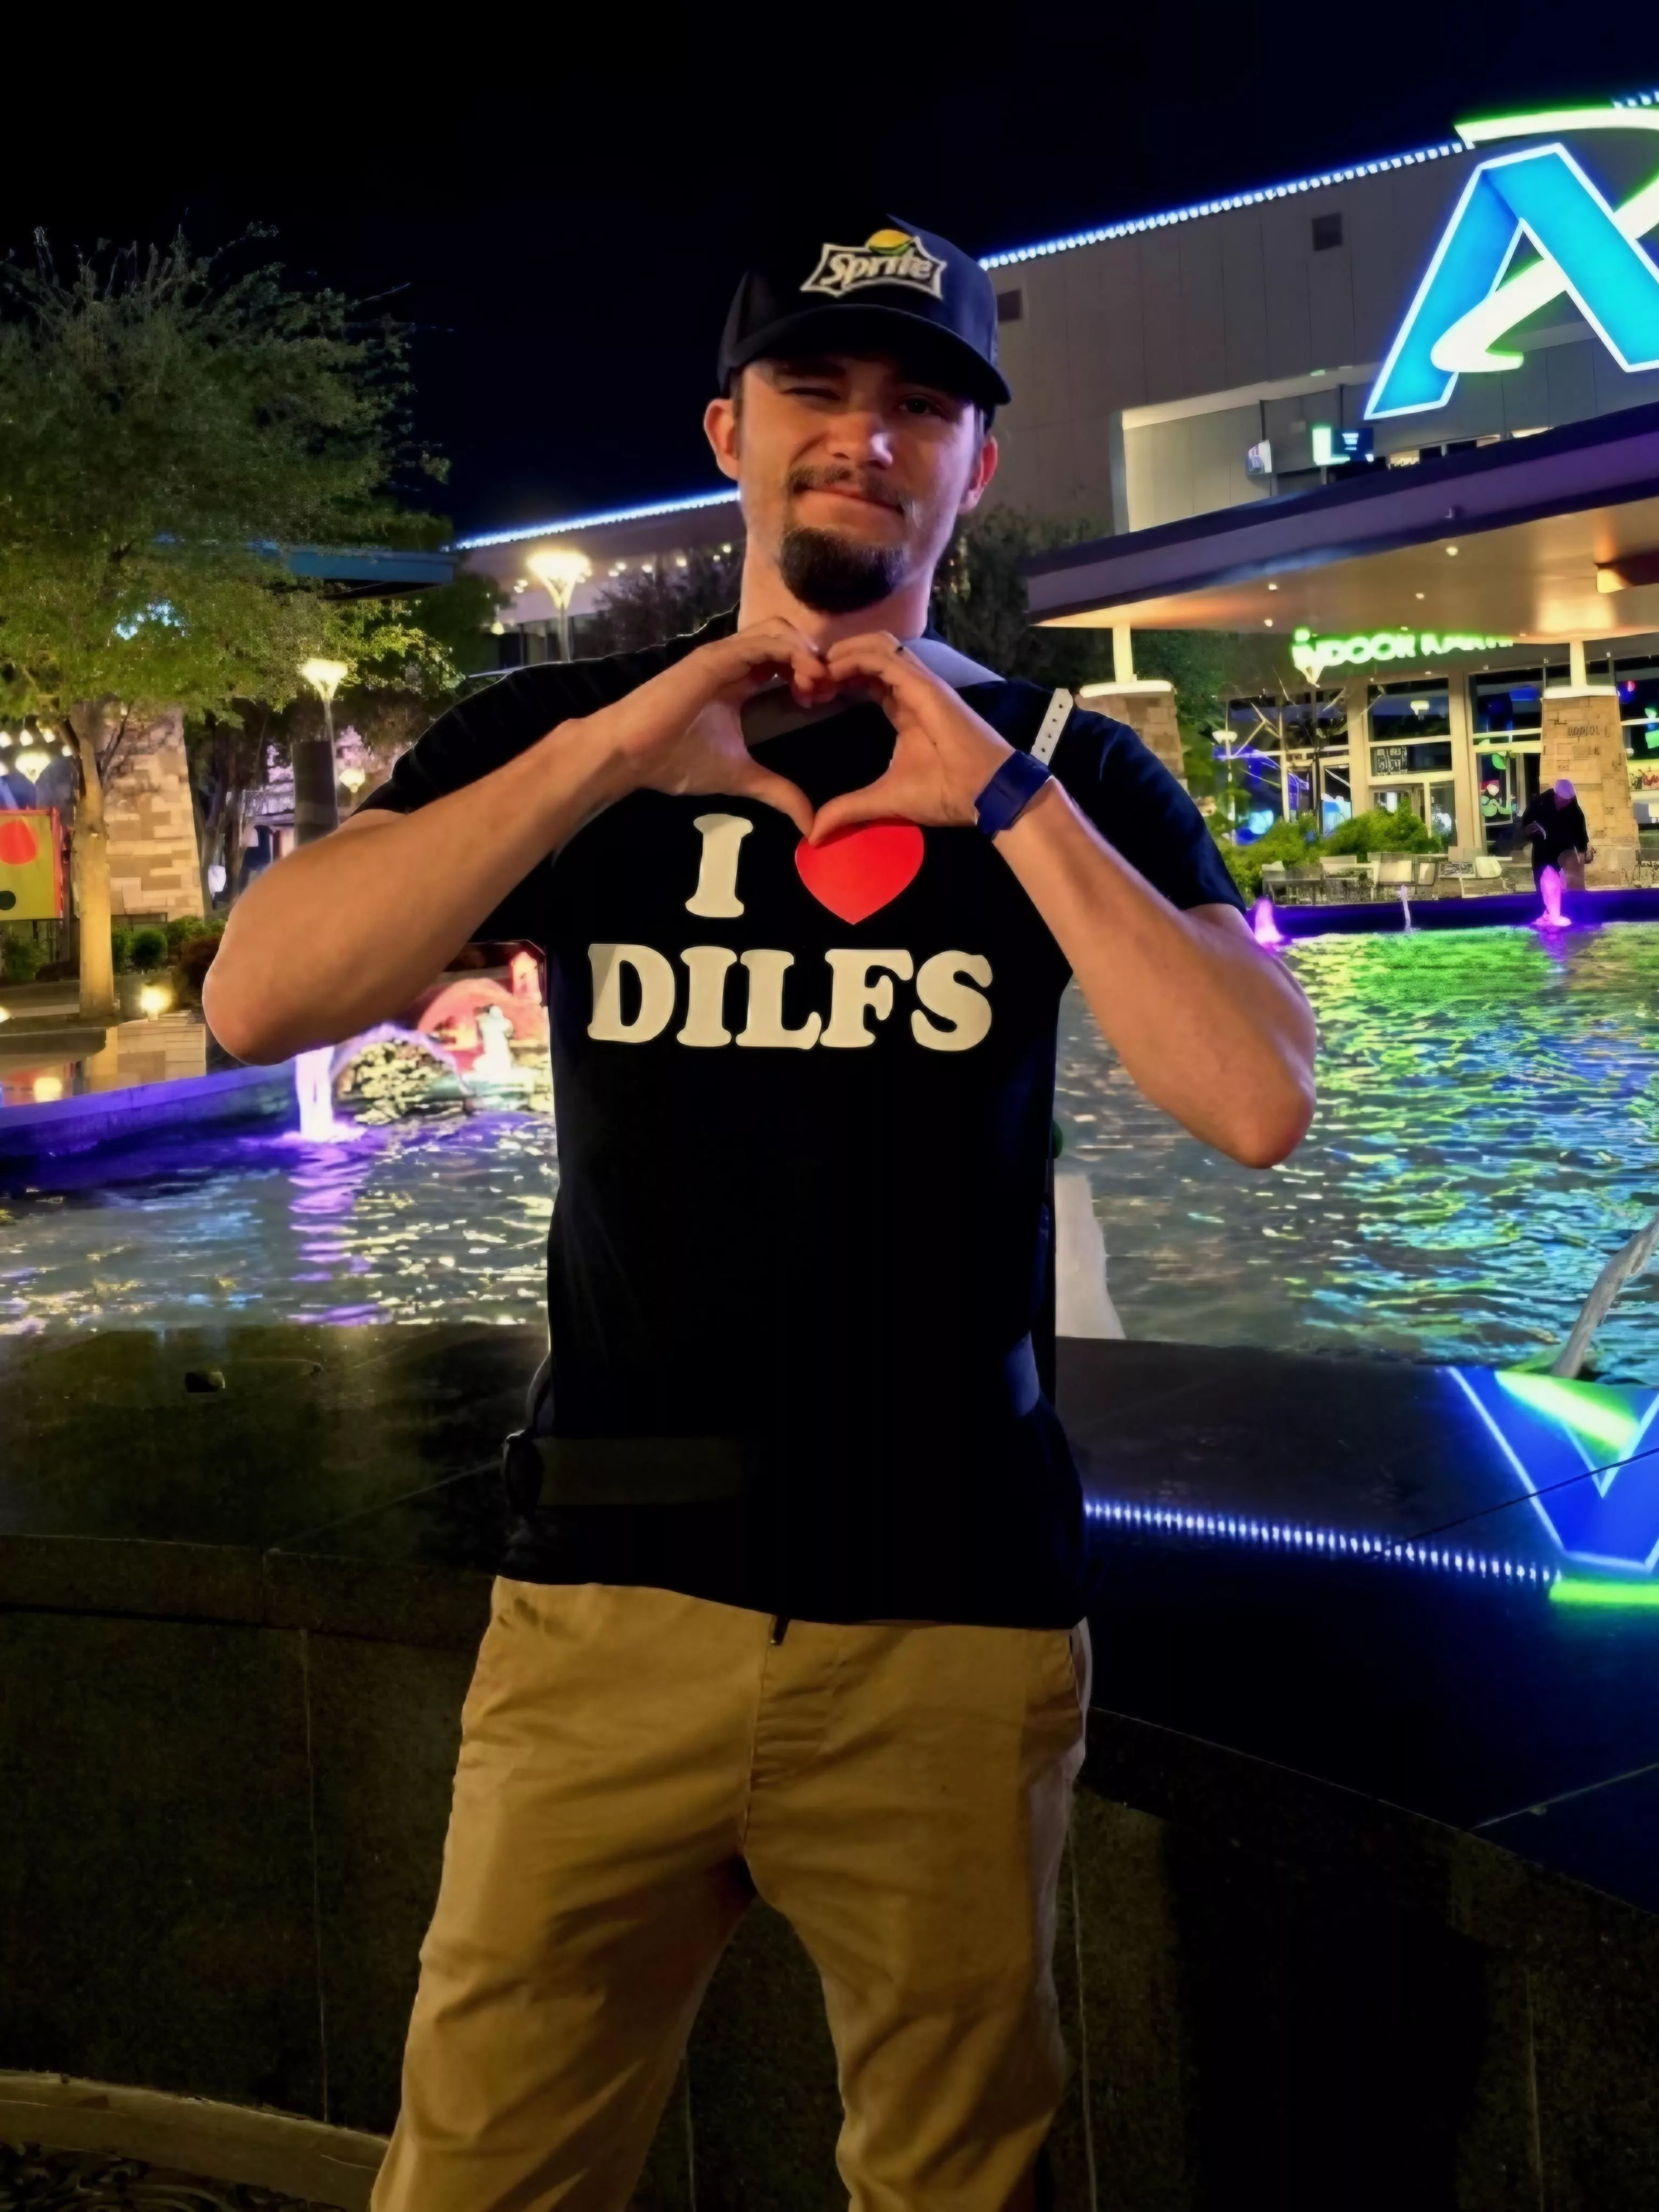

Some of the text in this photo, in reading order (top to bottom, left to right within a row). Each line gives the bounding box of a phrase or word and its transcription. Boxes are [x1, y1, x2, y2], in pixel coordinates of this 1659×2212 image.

[820, 247, 933, 288] Sprite
[685, 813, 753, 918] I
[588, 943, 993, 1051] DILFS
